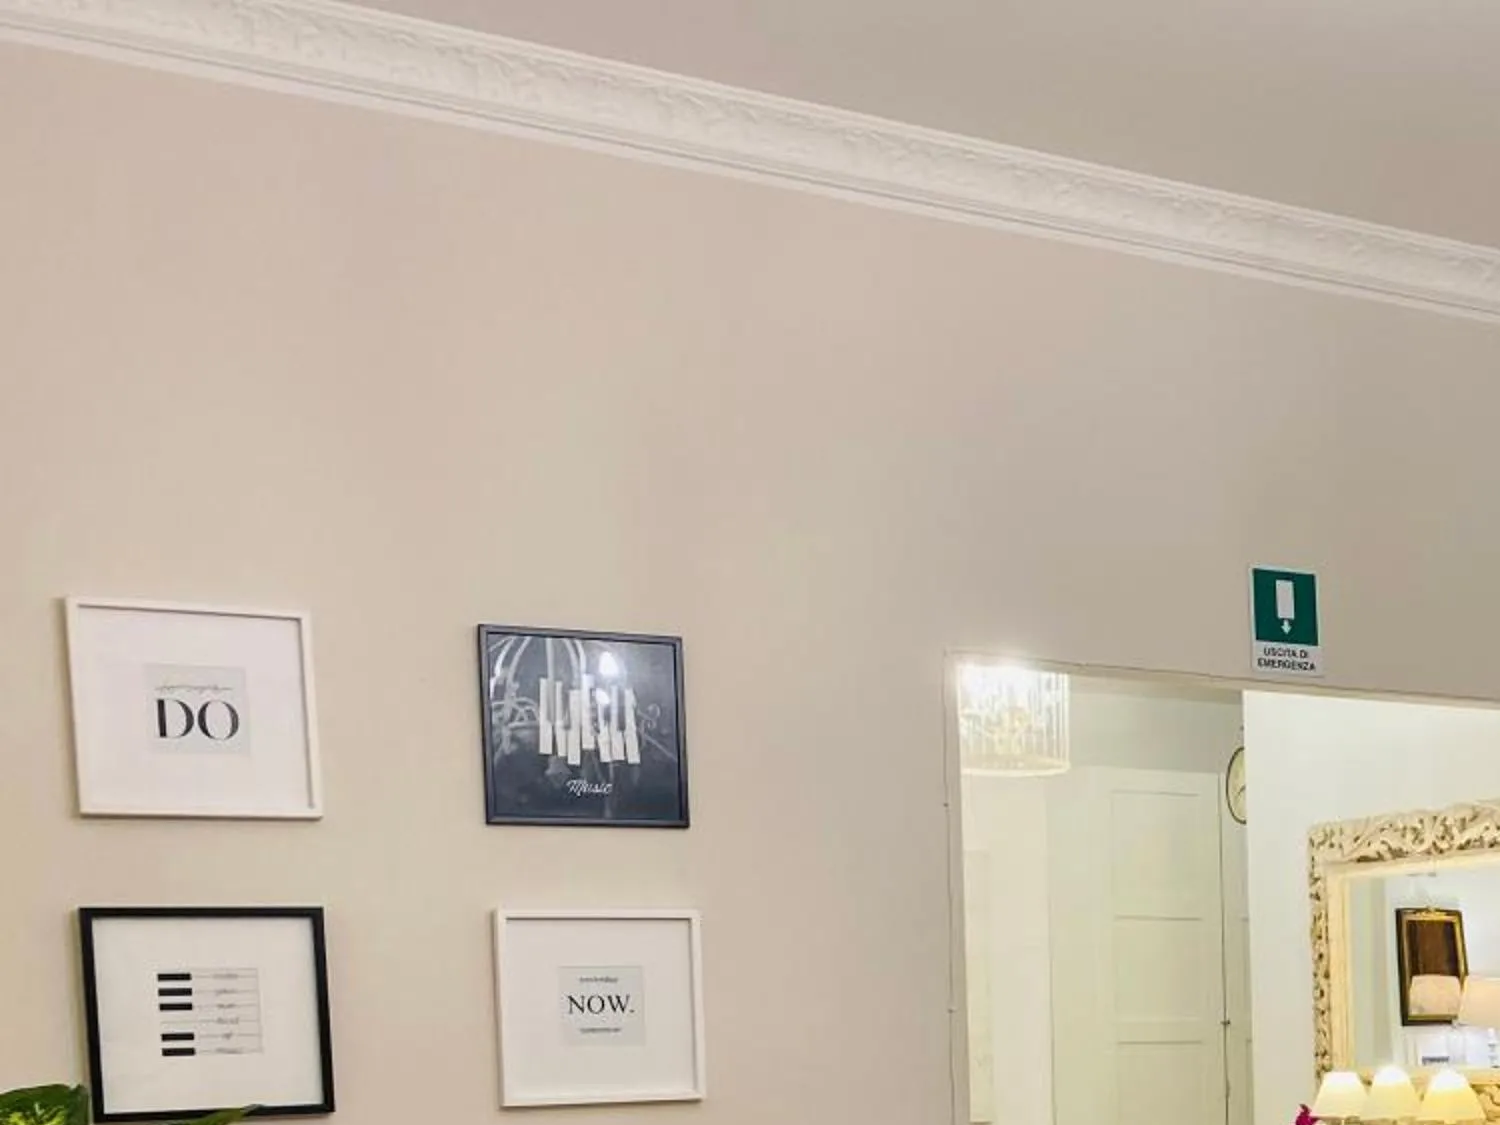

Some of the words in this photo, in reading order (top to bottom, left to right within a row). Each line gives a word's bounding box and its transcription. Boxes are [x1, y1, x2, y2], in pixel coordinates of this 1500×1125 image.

[1263, 646, 1297, 658] USCITA
[1257, 657, 1316, 671] EMERGENZA
[157, 698, 239, 740] DO
